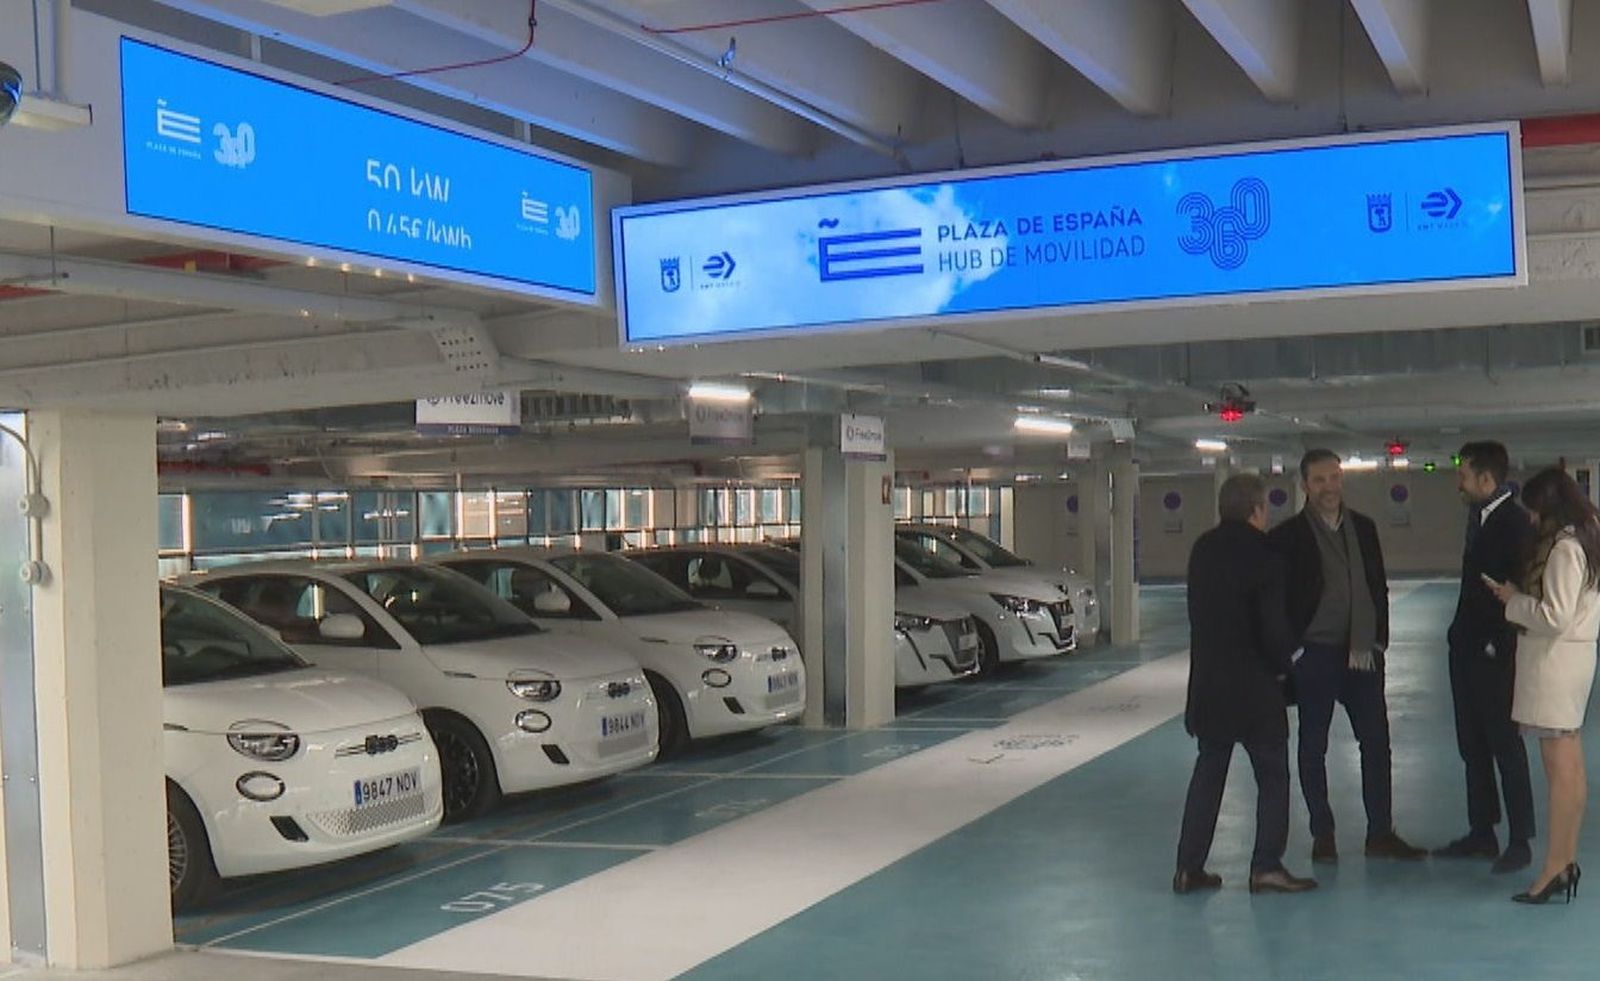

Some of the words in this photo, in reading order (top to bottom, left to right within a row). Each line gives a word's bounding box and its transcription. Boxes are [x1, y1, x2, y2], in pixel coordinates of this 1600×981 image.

[938, 220, 1008, 243] PLAZA
[1017, 215, 1044, 236] DE
[1052, 205, 1143, 233] ESPAÑA
[1177, 177, 1270, 270] 360
[939, 248, 983, 273] HUB
[991, 246, 1018, 268] DE
[1026, 234, 1146, 267] MOVILIDAD
[362, 777, 393, 801] 9847
[396, 770, 417, 793] NOV
[440, 880, 545, 914] 075
